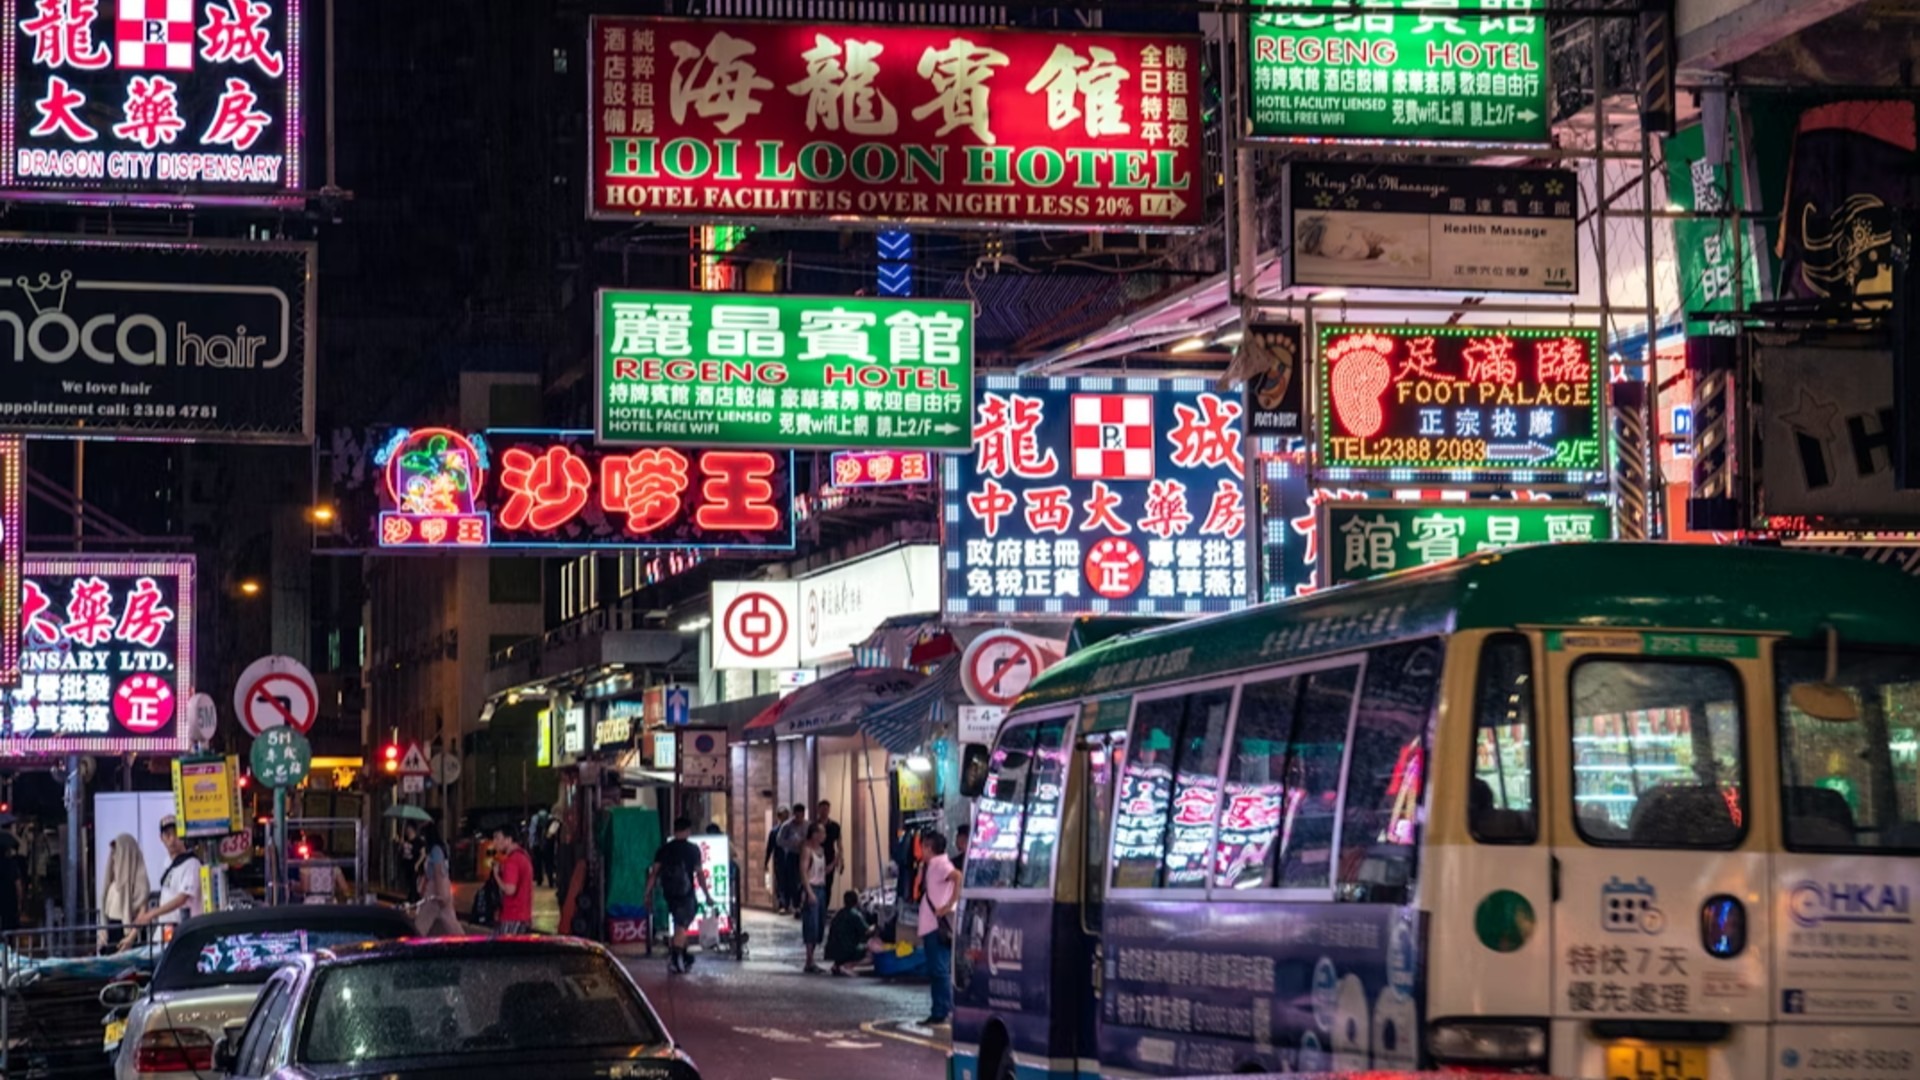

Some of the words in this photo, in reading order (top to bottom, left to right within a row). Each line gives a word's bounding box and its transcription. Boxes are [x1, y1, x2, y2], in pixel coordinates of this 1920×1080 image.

[1255, 36, 1397, 65] REGENG
[1427, 40, 1538, 69] HOTEL
[669, 30, 1130, 144] 海龍賓館
[1256, 95, 1292, 109] HOTEL
[1295, 96, 1340, 110] FACILITY
[1342, 97, 1386, 111] LIENSED
[1256, 110, 1291, 123] HOTEL
[1294, 111, 1320, 124] FREE
[1321, 112, 1344, 125] WIFI
[18, 150, 104, 177] DRAGON
[108, 152, 154, 178] CITY
[157, 153, 281, 182] DISPENSARY
[606, 137, 742, 180] HOI
[755, 140, 948, 184] LOON
[963, 145, 1191, 190] HOTEL
[1378, 174, 1449, 197] Massage
[606, 185, 697, 207] HOTEL
[704, 186, 851, 211] FACILITEIS
[858, 190, 928, 213] OVER
[943, 193, 1020, 214] NIGHT
[1026, 195, 1089, 216] LESS
[1095, 196, 1133, 217] 20%
[1444, 223, 1486, 234] Health
[1491, 225, 1547, 238] Massage
[176, 321, 266, 367] hair
[609, 302, 965, 365] 麗晶賓館
[613, 358, 789, 384] REGENG
[823, 364, 959, 391] HOTEL
[62, 381, 82, 393] We
[86, 381, 117, 394] love
[121, 382, 152, 395] hair
[1397, 381, 1470, 404] FOOT
[1479, 383, 1592, 406] PALACE
[97, 403, 129, 415] call:
[133, 404, 176, 417] 2388
[180, 405, 217, 418] 4781
[609, 408, 653, 420] HOTEL
[656, 409, 714, 422] FACILITY
[717, 410, 772, 423] LIENSED
[609, 421, 653, 432] HOTEL
[656, 422, 688, 433] FREE
[690, 423, 719, 434] WIFI
[1436, 438, 1486, 461] 2093
[1556, 441, 1592, 462] 2/F
[119, 651, 174, 670] LTD.
[711, 774, 725, 787] 12
[1829, 882, 1911, 914] HKAI
[1566, 946, 1688, 977] 特快7天
[1635, 1049, 1683, 1077] LH
